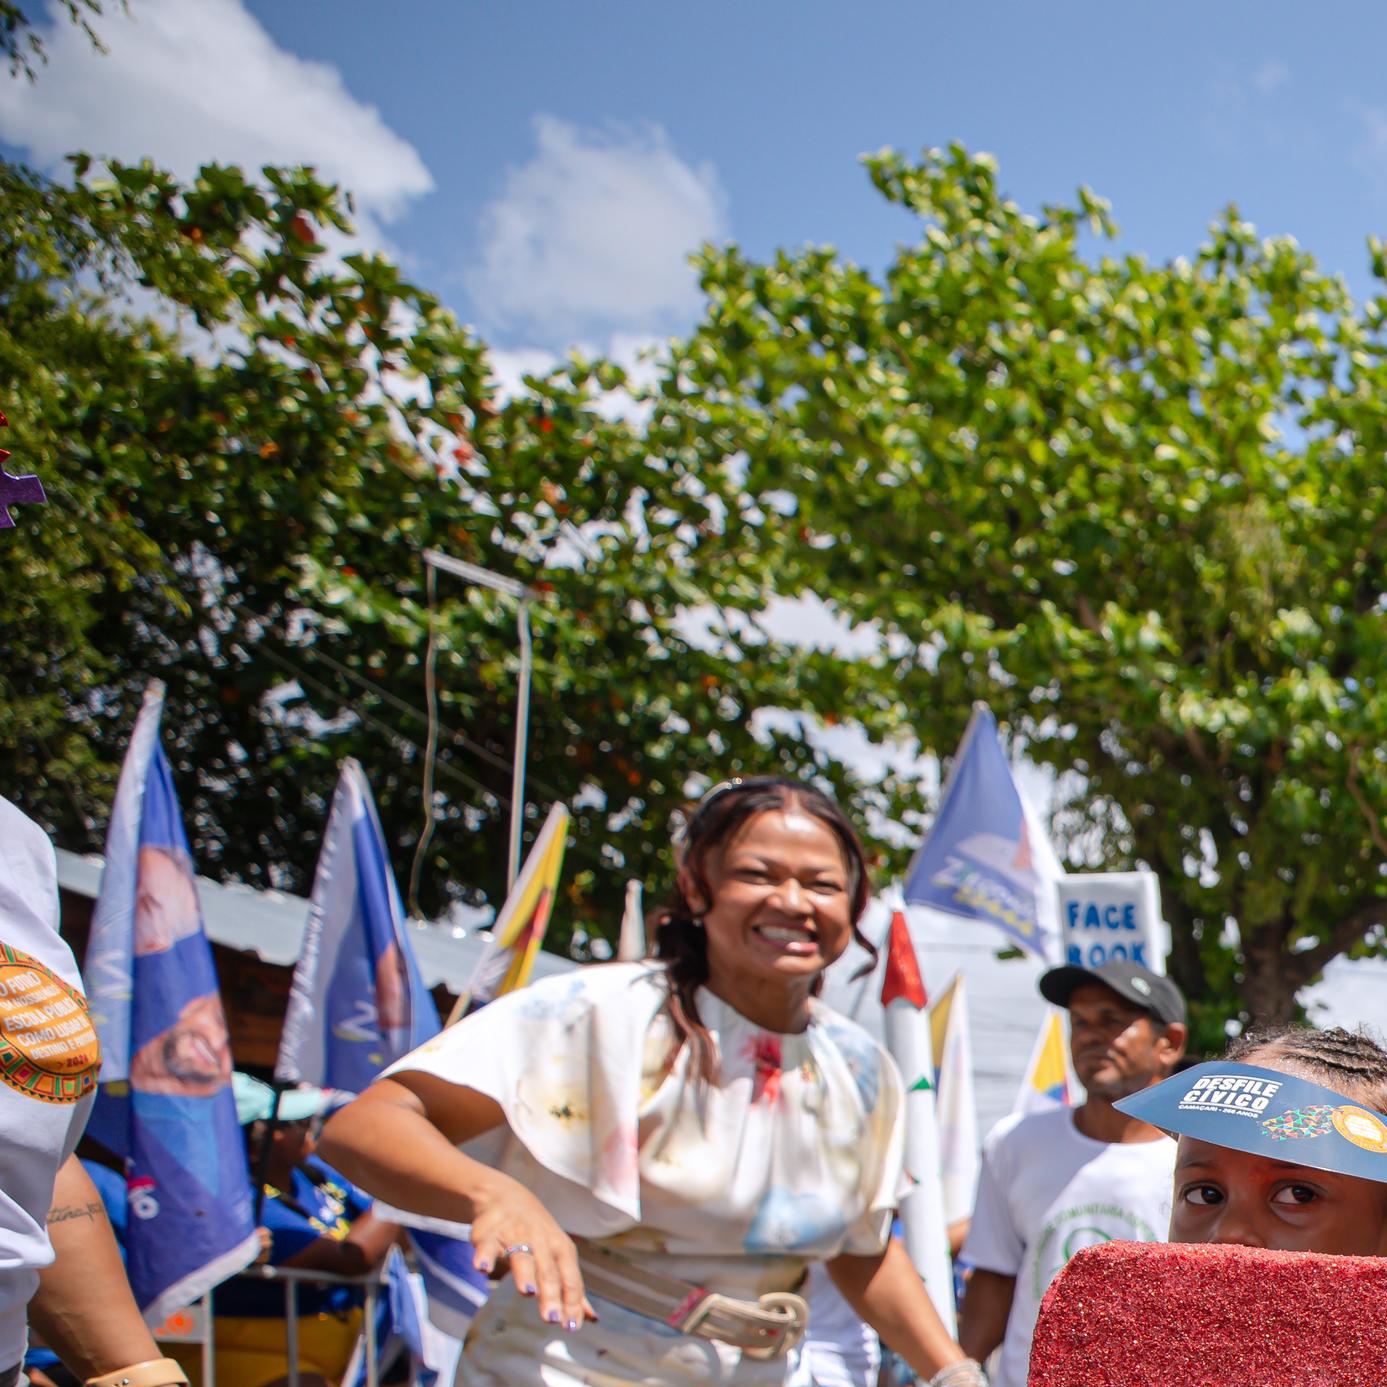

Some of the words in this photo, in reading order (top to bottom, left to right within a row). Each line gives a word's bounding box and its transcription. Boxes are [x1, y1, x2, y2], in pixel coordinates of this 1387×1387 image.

[1067, 903, 1137, 930] FACE
[1183, 1088, 1270, 1110] CÍVICO
[1192, 1078, 1280, 1098] DESFILE
